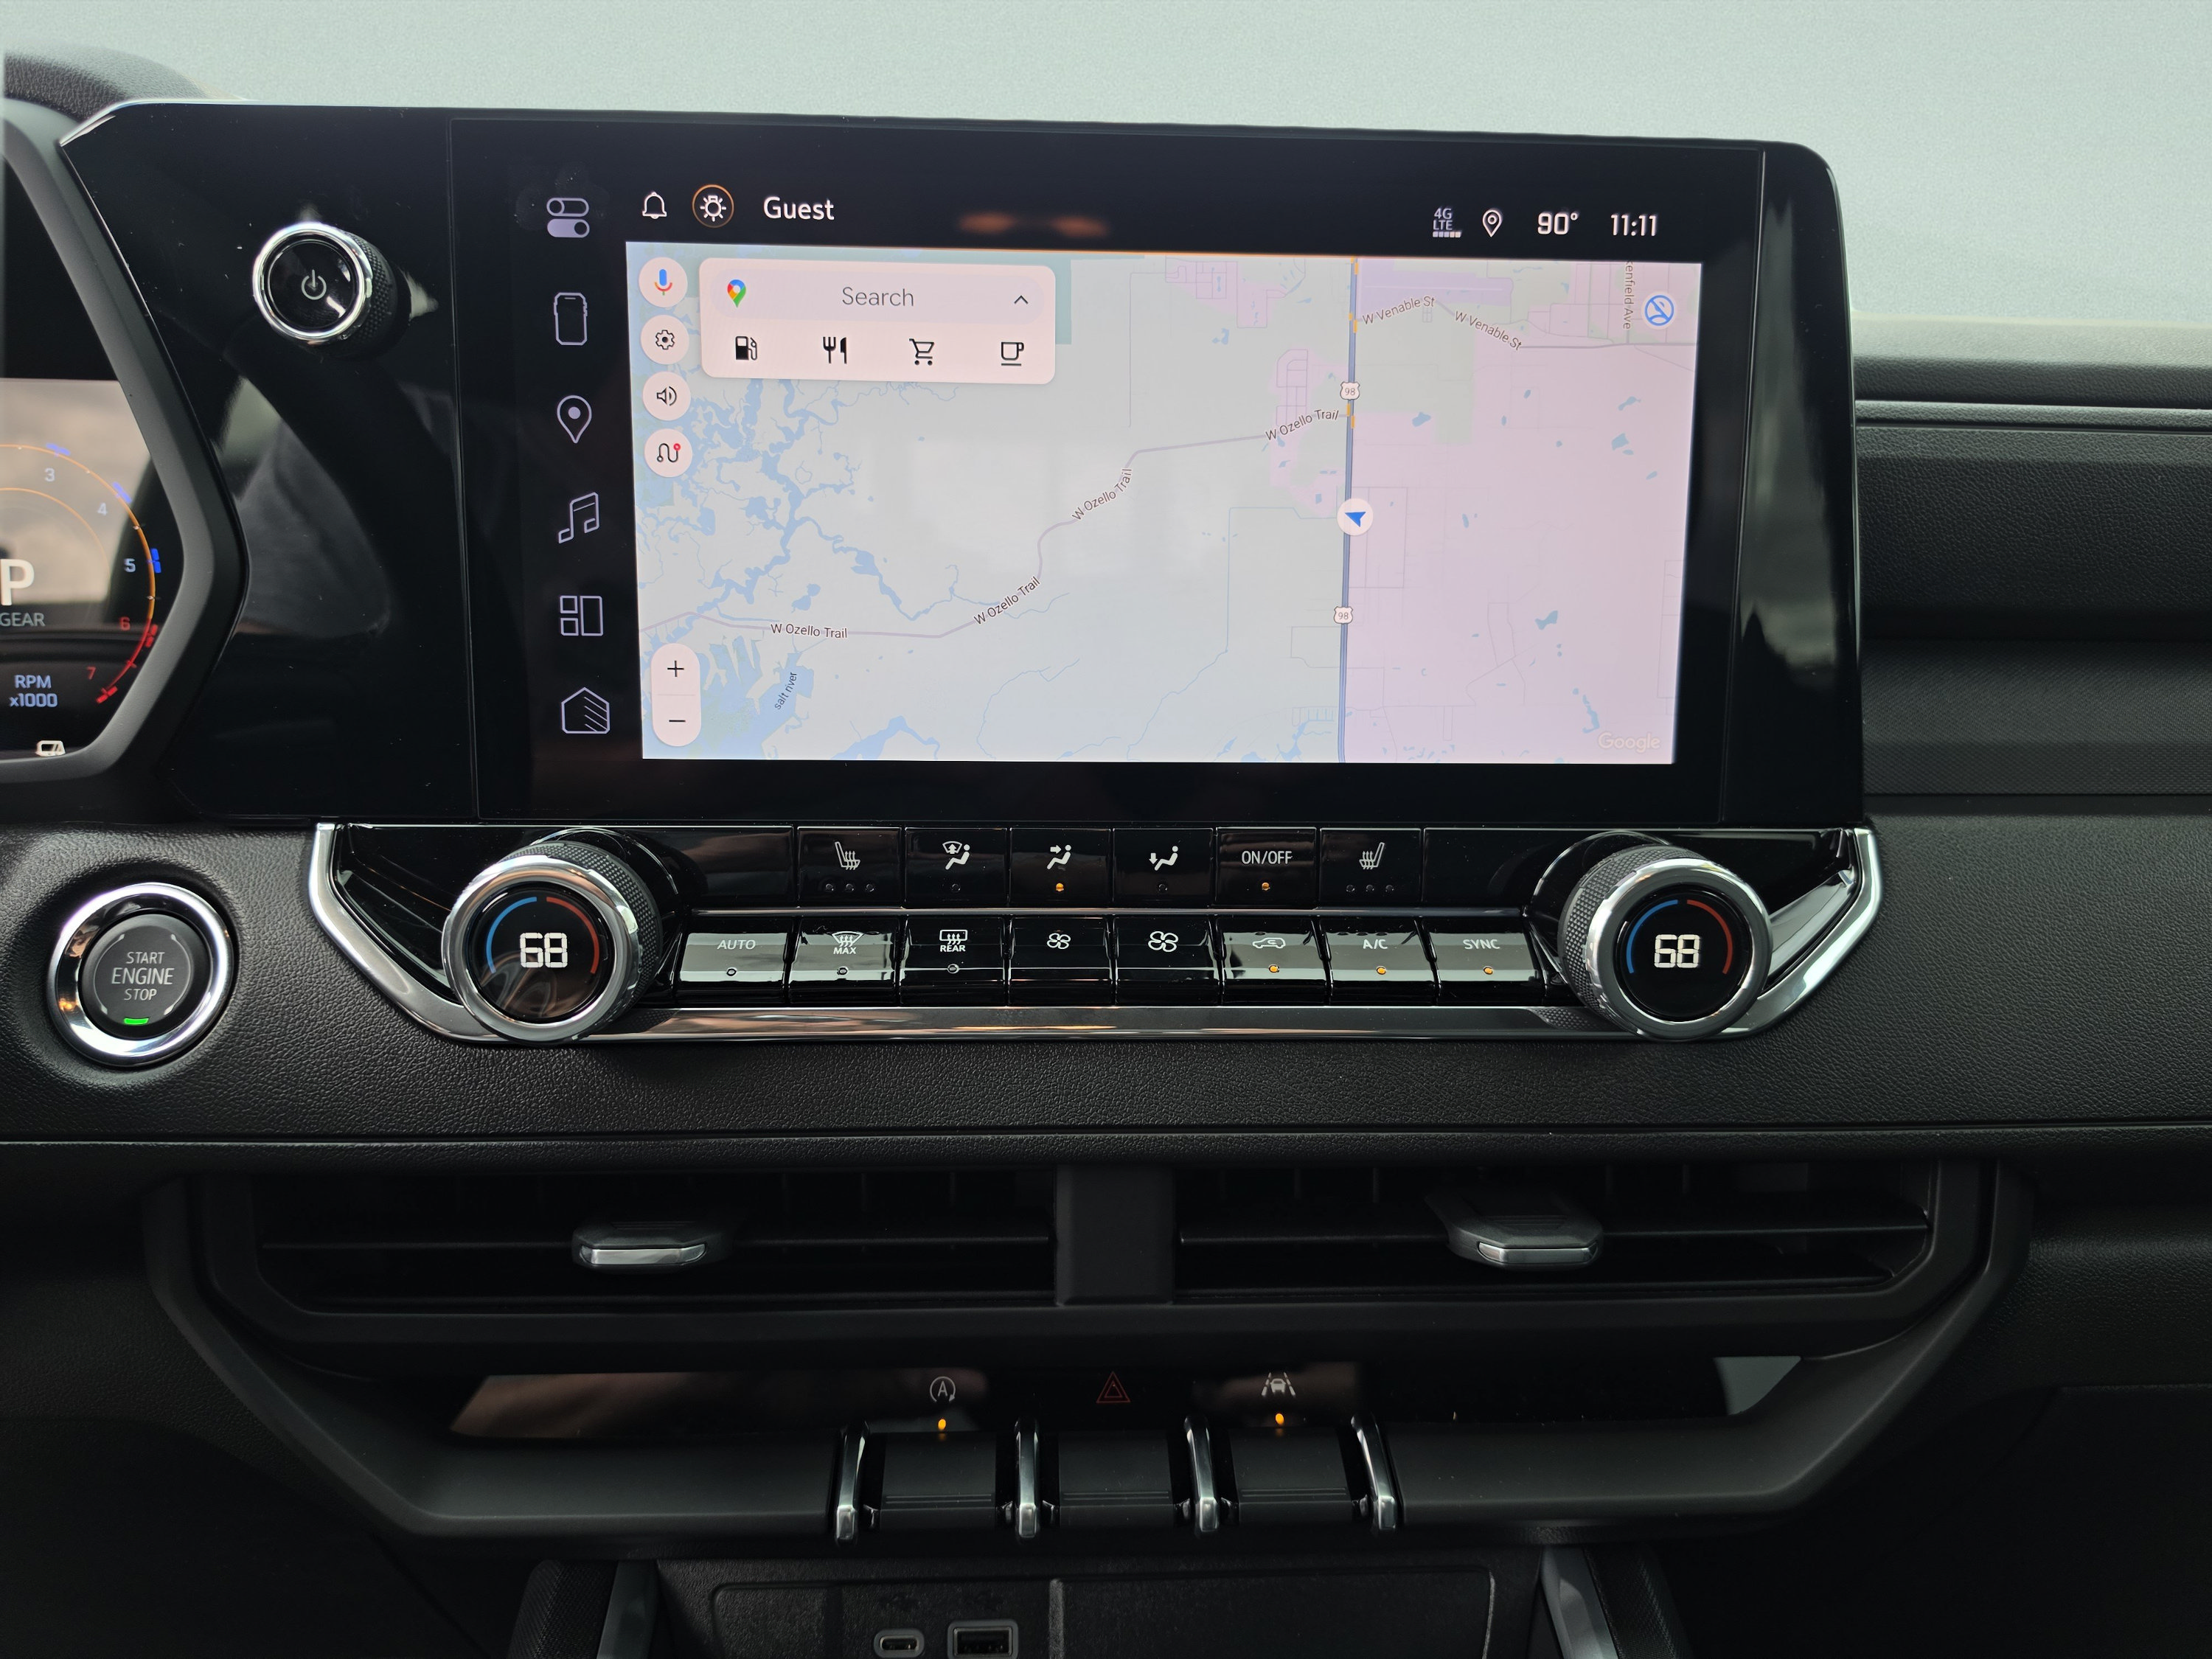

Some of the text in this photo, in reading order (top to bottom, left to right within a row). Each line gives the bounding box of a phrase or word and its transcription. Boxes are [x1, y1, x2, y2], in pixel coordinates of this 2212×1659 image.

[763, 195, 835, 220] Guest
[1433, 207, 1452, 220] 4G
[1433, 220, 1453, 231] LTE
[1537, 212, 1579, 234] 90°
[1610, 213, 1658, 237] 11:11
[842, 286, 914, 306] Search
[1363, 296, 1436, 324] W Venable St
[1623, 307, 1633, 330] Ave
[1455, 310, 1522, 351] W Venable St
[1344, 387, 1356, 396] 98
[1265, 409, 1339, 441] W Ozello Trail
[44, 467, 55, 482] 3
[1071, 468, 1132, 521] W Ozello Trail
[97, 502, 108, 516] 4
[124, 558, 136, 573] 5
[0, 558, 35, 605] P
[973, 575, 1040, 625] W Ozello Trail
[0, 612, 46, 627] GEAR
[119, 616, 131, 631] 6
[1338, 612, 1349, 620] 98
[771, 623, 847, 639] W Ozello Trail
[87, 666, 97, 680] 7
[14, 675, 52, 689] RPM
[774, 672, 797, 710] salt river
[9, 693, 58, 707] x1000
[1598, 731, 1661, 753] Google
[1242, 850, 1293, 865] ON/OFF
[519, 932, 568, 968] 68
[717, 939, 757, 950] AUTO
[833, 946, 857, 955] MAX
[939, 945, 966, 953] REAR
[1363, 939, 1388, 950] A/C
[1463, 939, 1500, 950] SYNC
[1654, 933, 1700, 968] 68
[125, 951, 166, 964] START
[111, 967, 175, 985] ENGINE
[123, 988, 158, 1001] STOP
